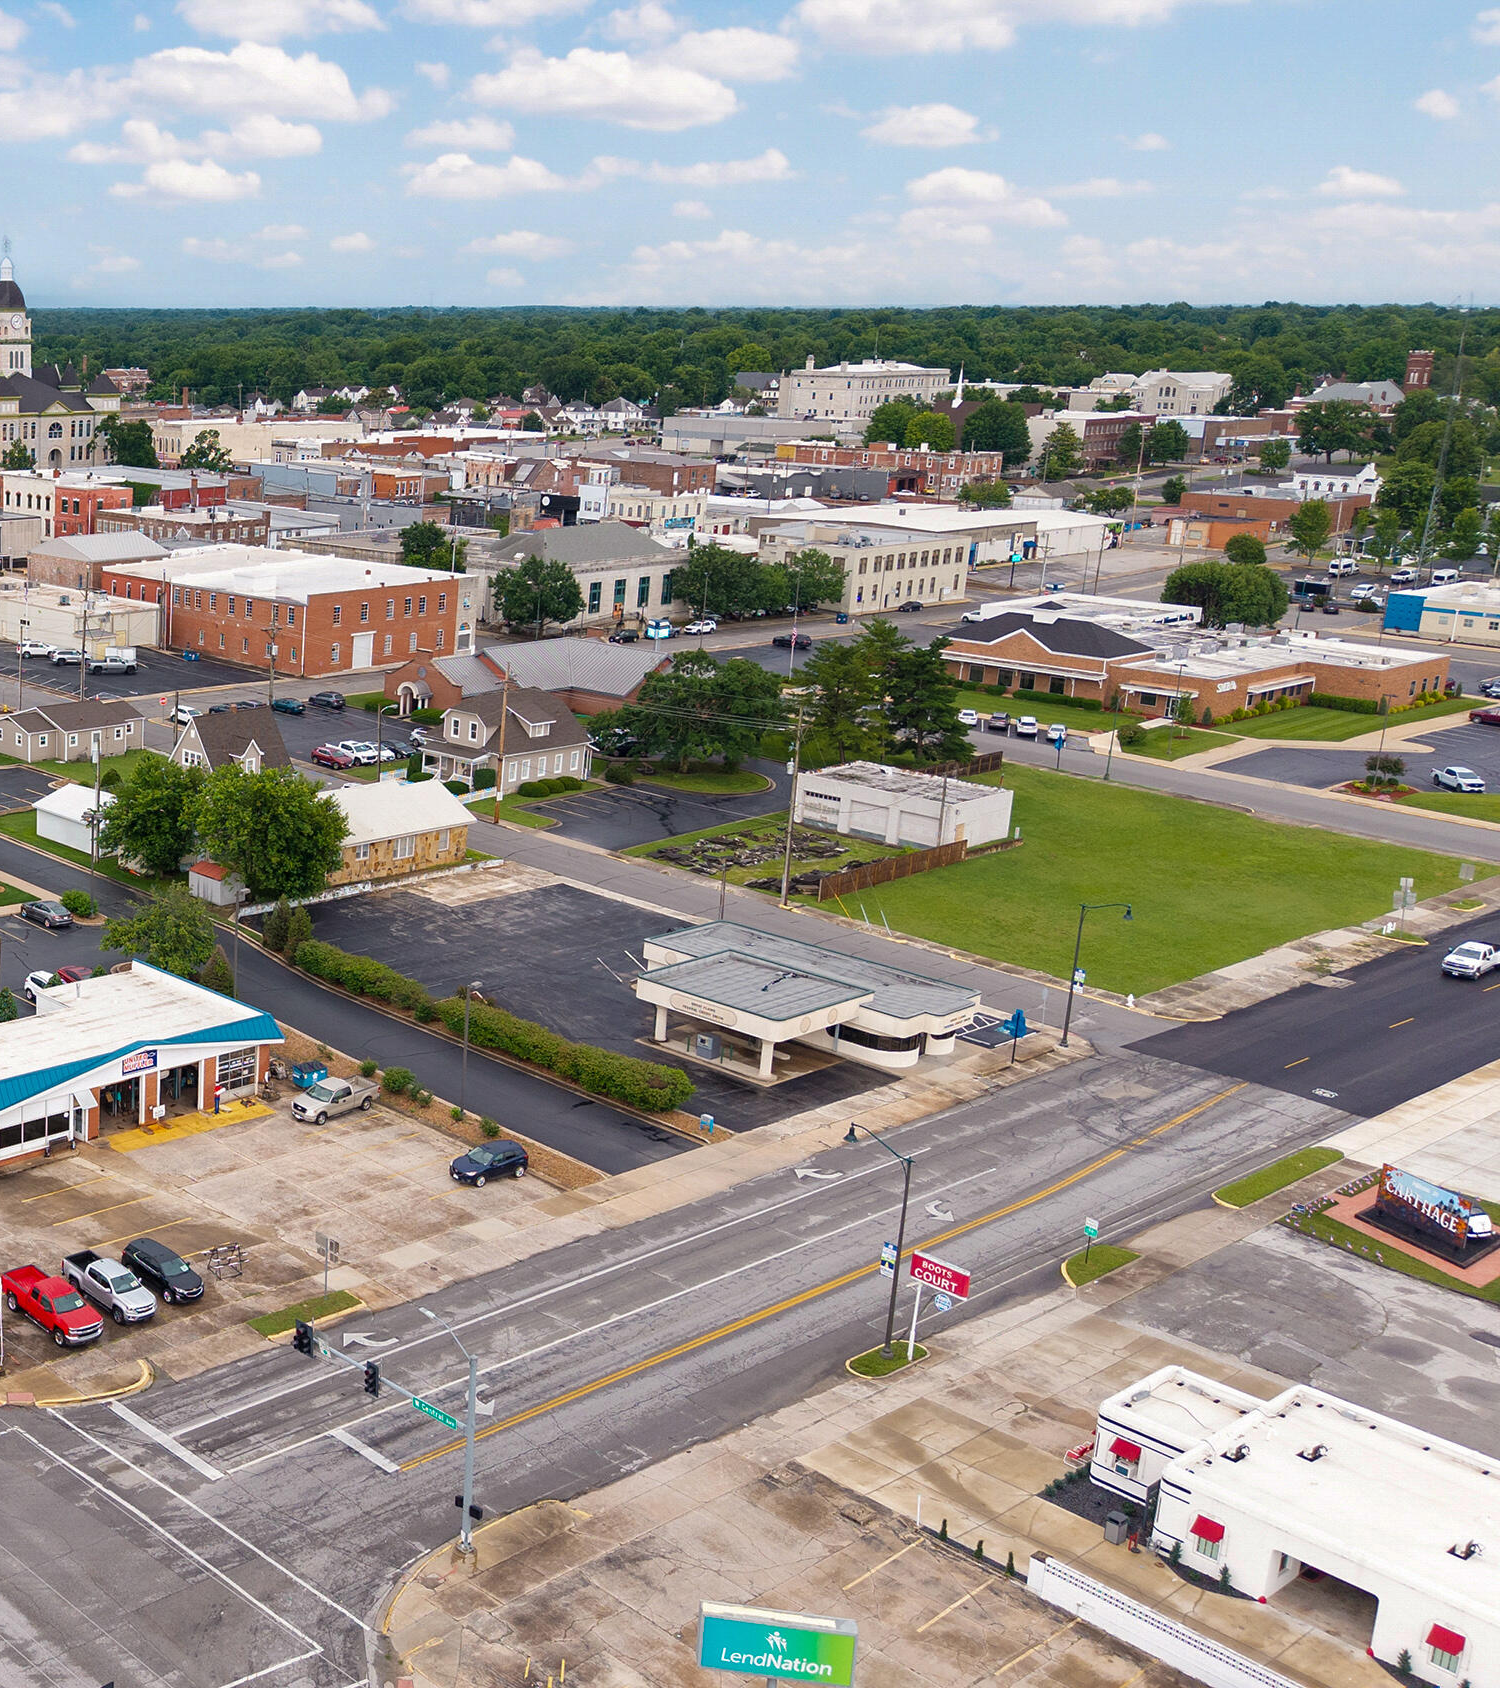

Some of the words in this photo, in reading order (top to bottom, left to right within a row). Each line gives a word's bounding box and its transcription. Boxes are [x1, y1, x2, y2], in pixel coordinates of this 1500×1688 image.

[123, 1052, 148, 1066] UNITED
[123, 1058, 154, 1073] MUFFLER
[1385, 1180, 1459, 1233] CARTHAGE
[914, 1268, 958, 1293] COURT
[921, 1260, 953, 1279] BOOTS
[421, 1403, 444, 1422] Central
[445, 1418, 455, 1427] Ave
[721, 1647, 833, 1677] LendNation
